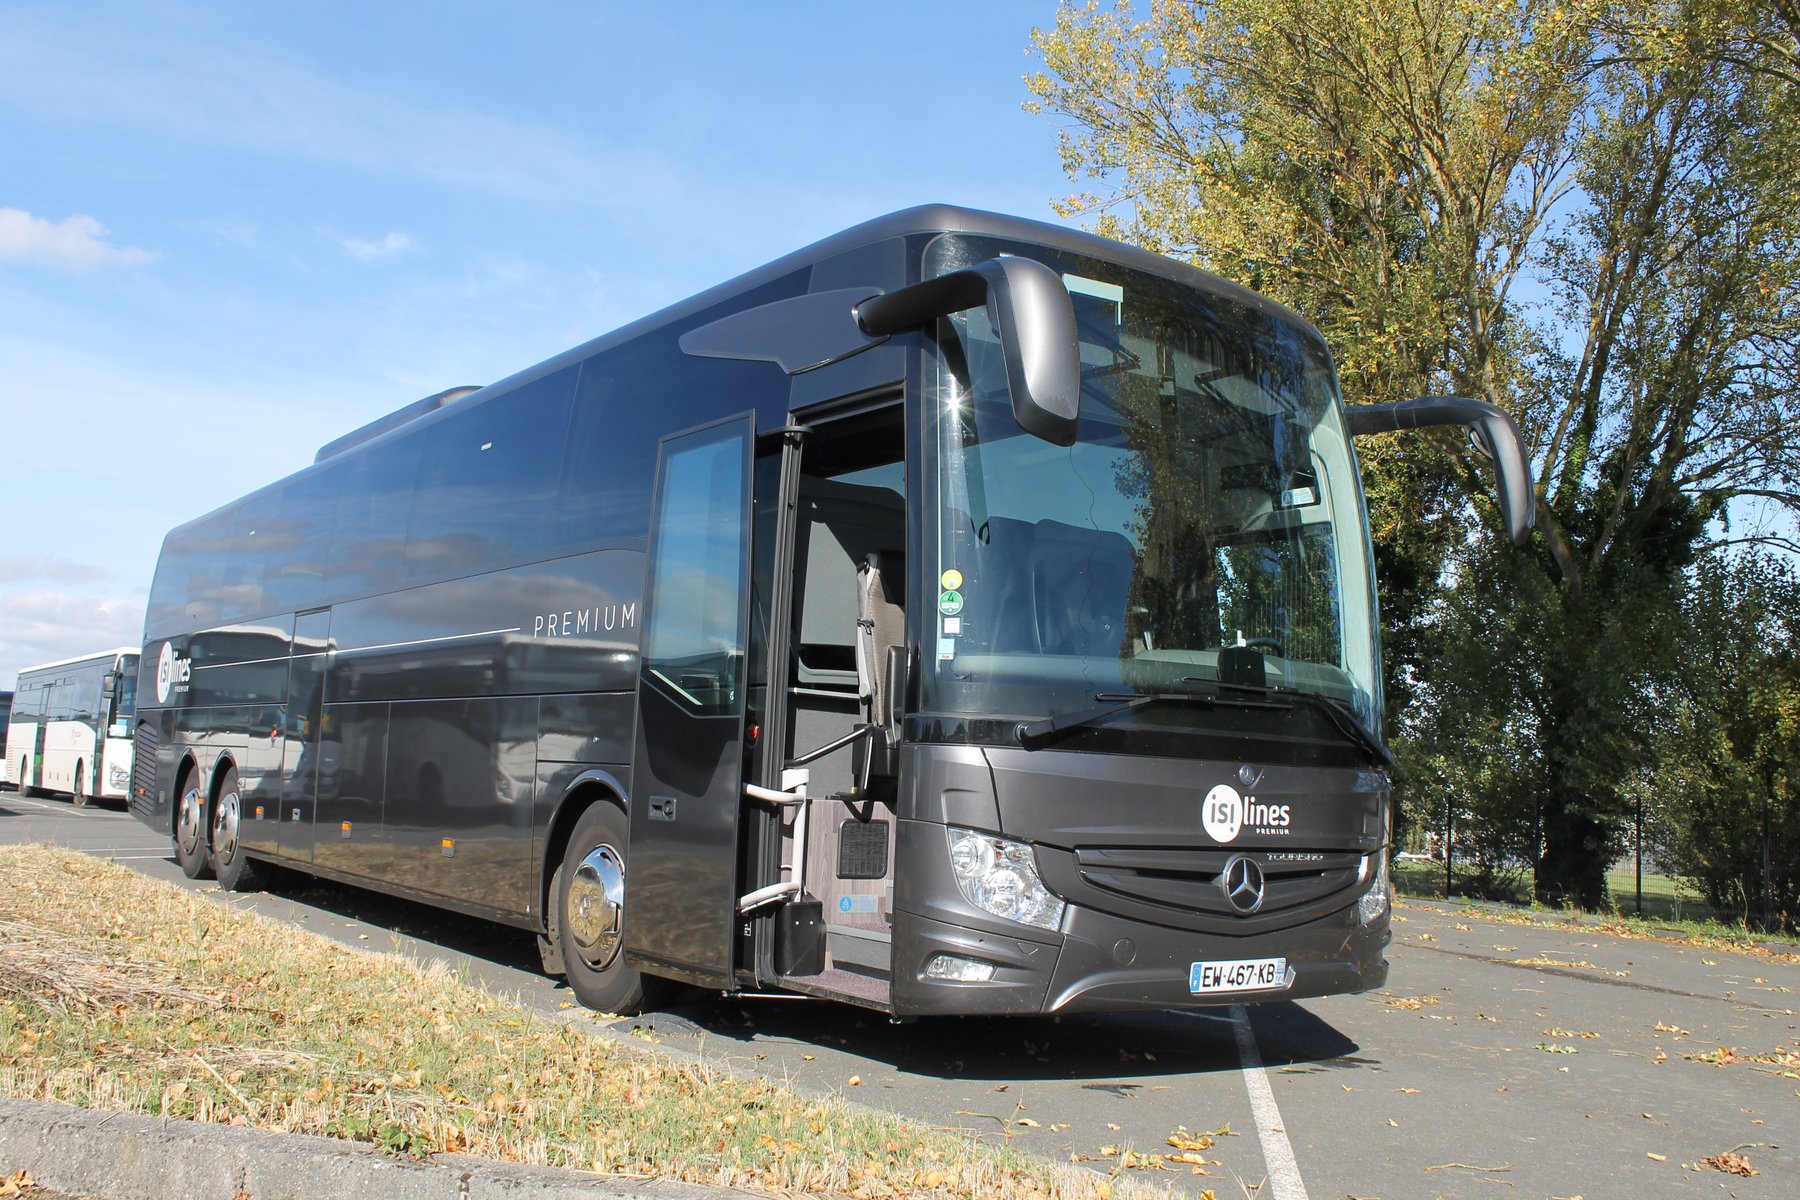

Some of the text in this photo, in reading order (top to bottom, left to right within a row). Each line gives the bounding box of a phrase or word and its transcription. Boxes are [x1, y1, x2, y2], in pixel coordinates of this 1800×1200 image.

[947, 592, 954, 603] 4
[533, 602, 636, 639] PREMIUM
[1255, 828, 1290, 836] PREMIUM
